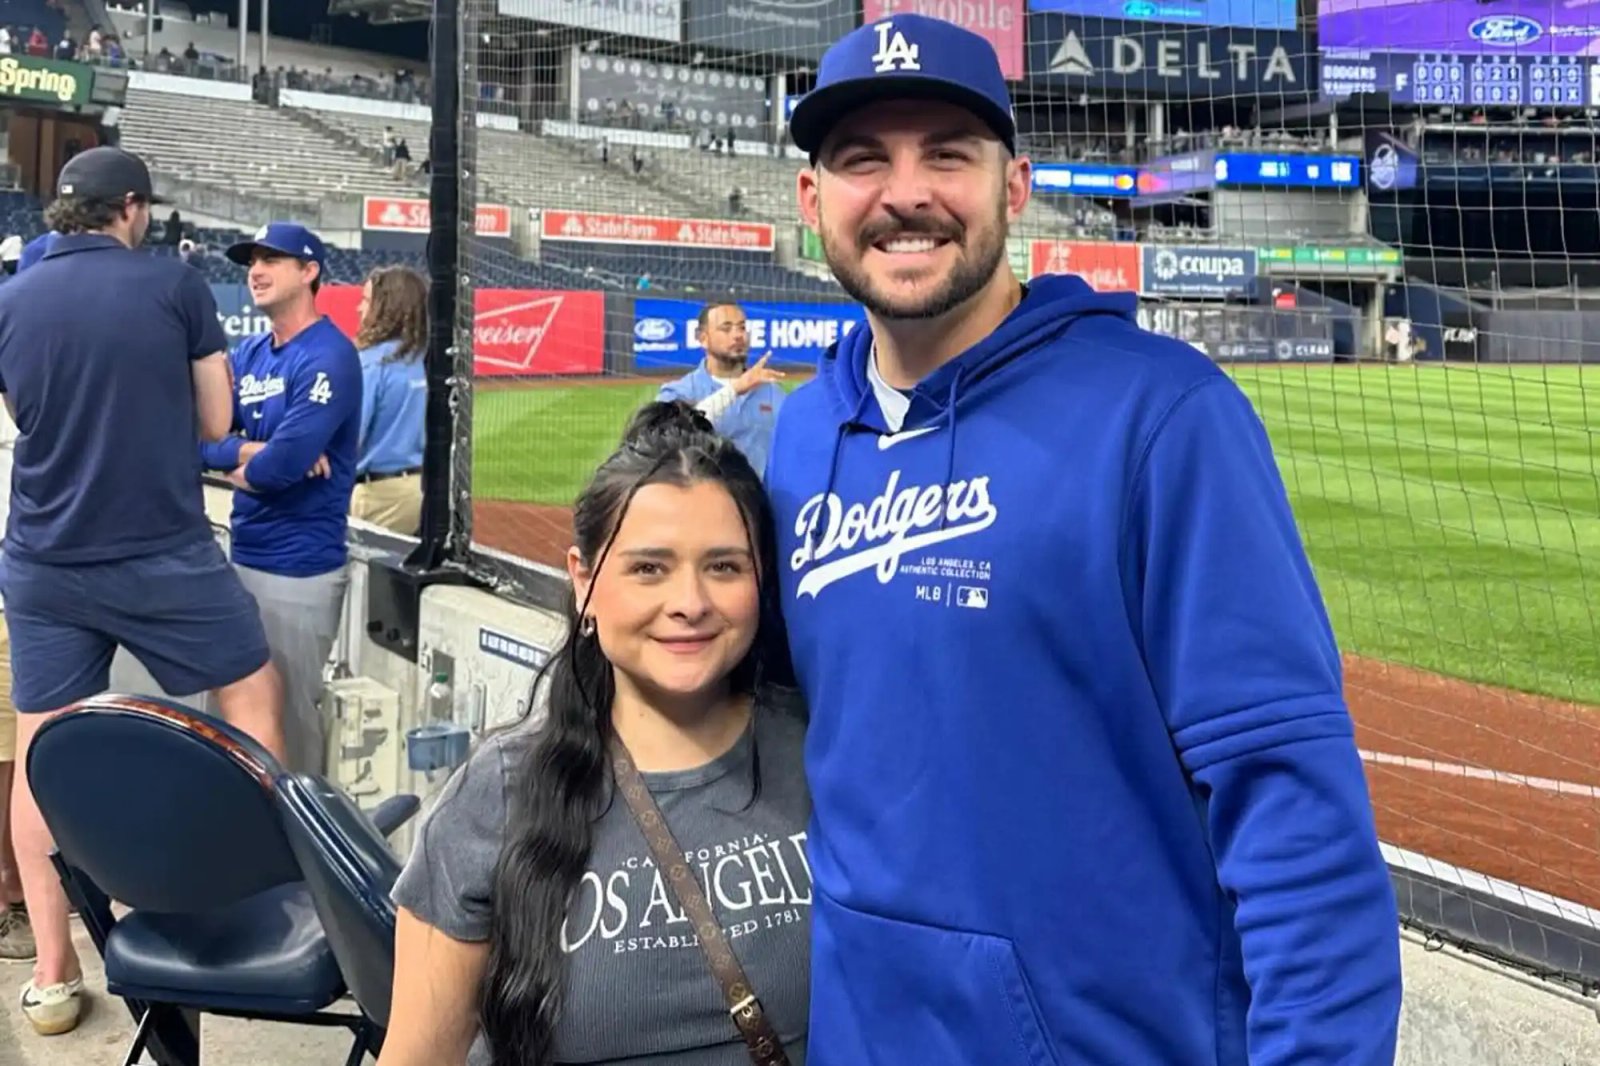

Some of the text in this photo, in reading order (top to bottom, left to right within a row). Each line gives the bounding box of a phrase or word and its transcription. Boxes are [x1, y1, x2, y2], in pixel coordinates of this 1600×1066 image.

[872, 22, 920, 72] LA
[1112, 36, 1296, 83] DELTA
[0, 57, 76, 100] Spring
[1396, 73, 1407, 91] F
[1180, 255, 1244, 282] coupa
[770, 319, 838, 348] HOME
[309, 372, 332, 404] LA
[791, 470, 997, 598] Dodgers
[900, 565, 991, 580] AUTHENTIC COLLECTION
[921, 557, 936, 565] LOS
[979, 561, 991, 570] CA
[915, 585, 941, 601] MLB
[626, 834, 766, 868] CAFORNIA
[560, 831, 813, 953] OS AGEL
[614, 908, 801, 953] ESTABLIED 1781
